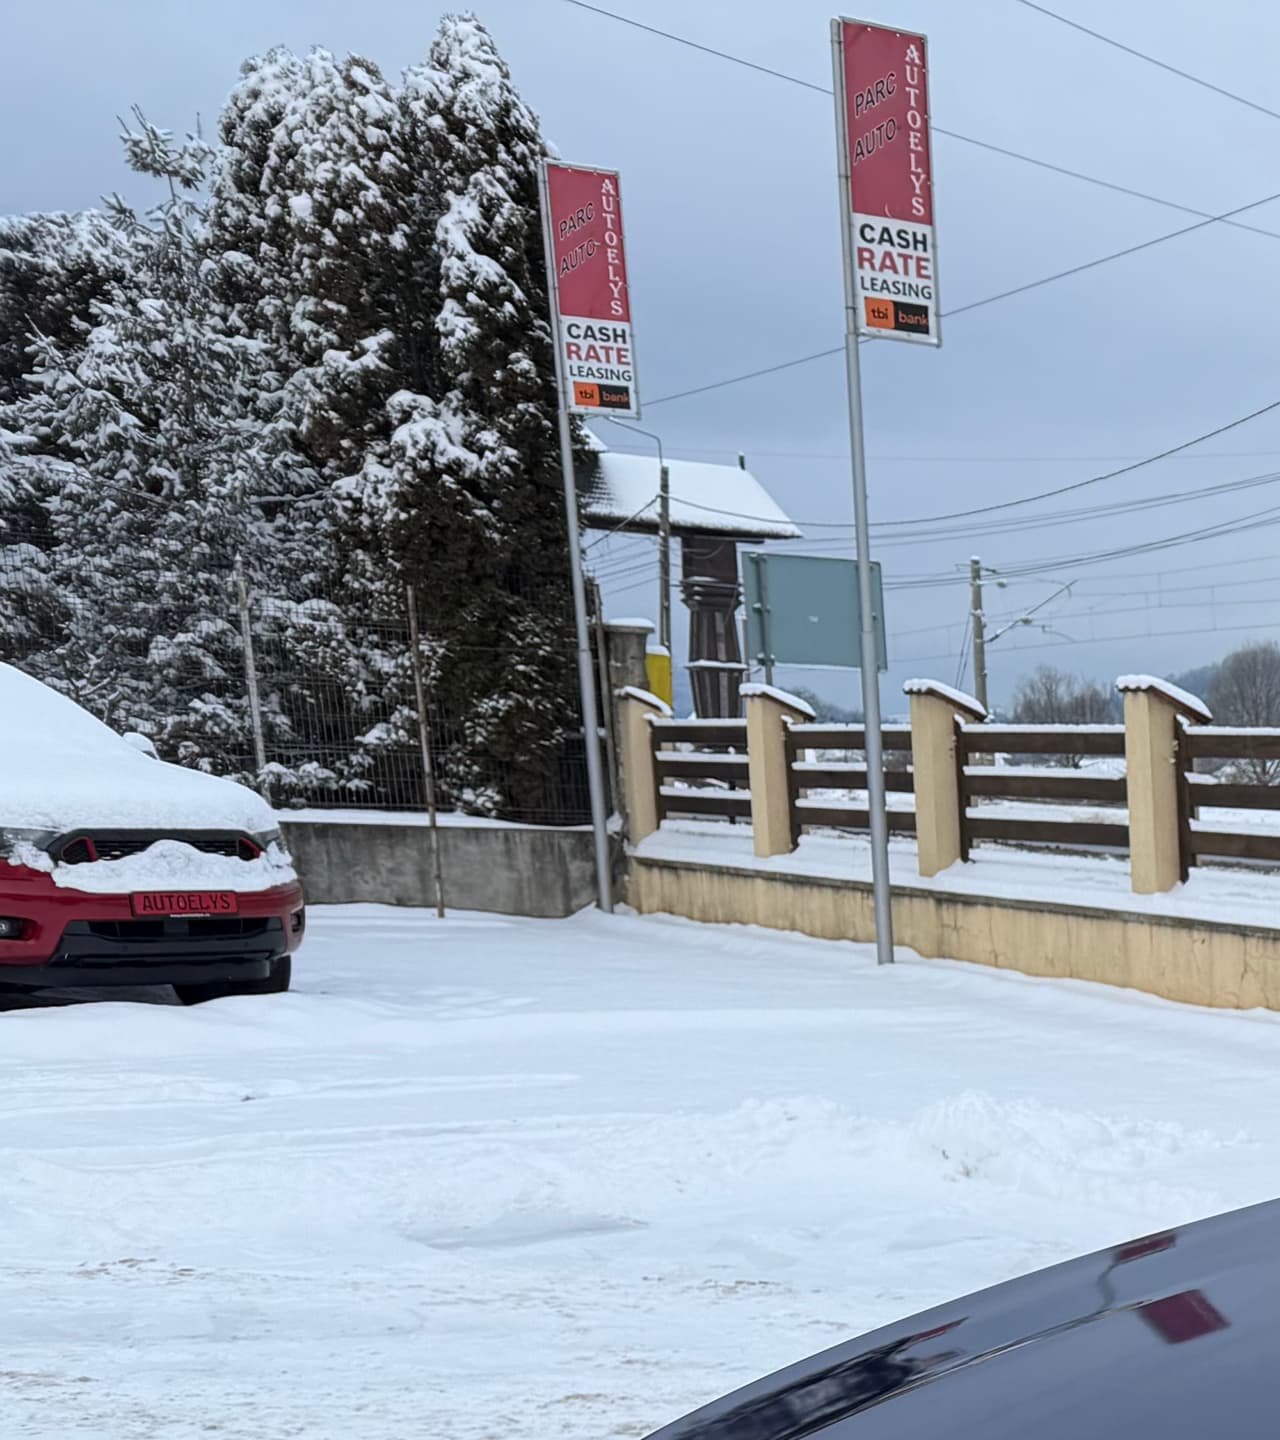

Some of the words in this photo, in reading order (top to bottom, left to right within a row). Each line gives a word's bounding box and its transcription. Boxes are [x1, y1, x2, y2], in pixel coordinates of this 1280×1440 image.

[855, 72, 897, 118] PARC
[853, 117, 897, 166] AUTO
[904, 43, 926, 217] AUTOELYS
[559, 202, 595, 241] PARC
[601, 178, 624, 317] AUTOELYS
[859, 223, 928, 252] CASH
[559, 241, 598, 278] AUTO
[856, 246, 932, 280] RATE
[860, 275, 932, 300] LEASING
[871, 307, 889, 320] tbi
[898, 310, 929, 326] bank
[566, 323, 627, 345] CASH
[565, 342, 631, 366] RATE
[569, 365, 633, 382] LEASING
[579, 389, 595, 400] tbi
[143, 894, 231, 911] AUTOELYS
